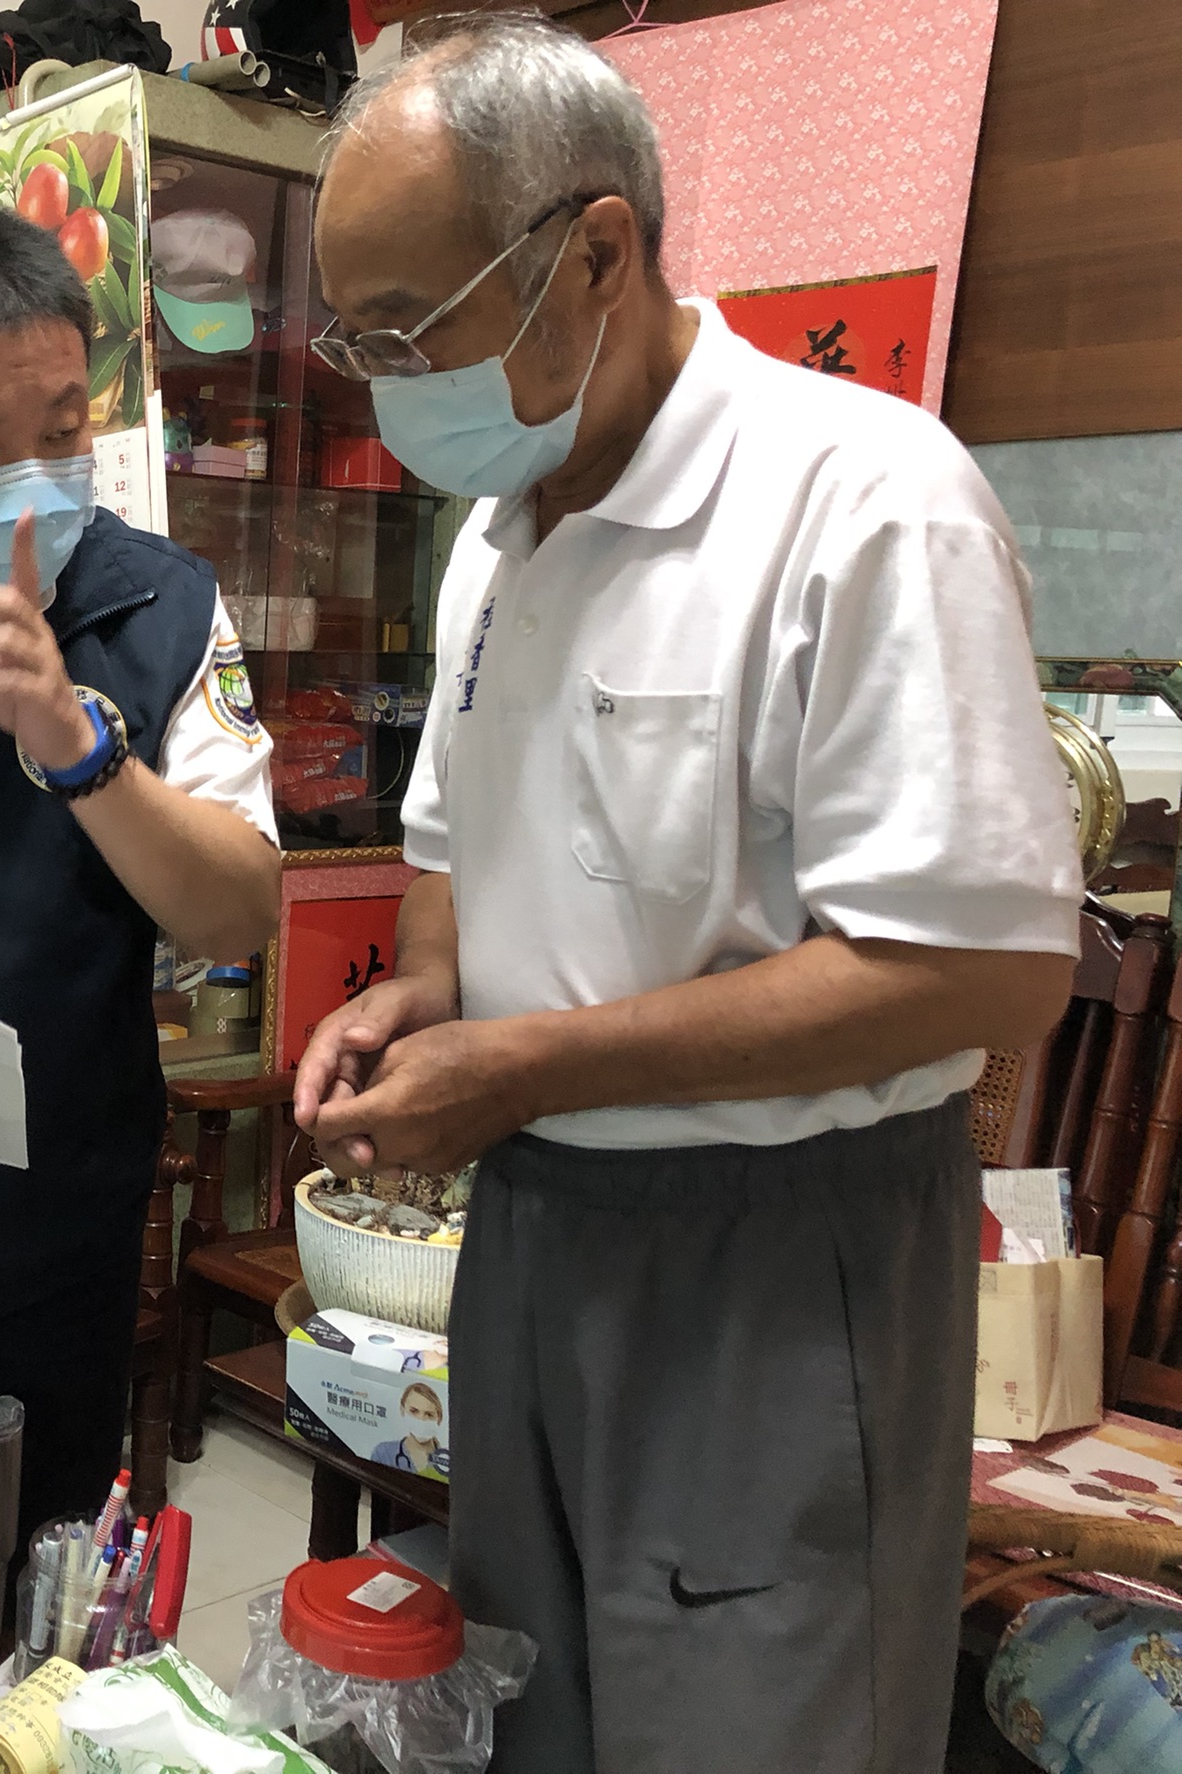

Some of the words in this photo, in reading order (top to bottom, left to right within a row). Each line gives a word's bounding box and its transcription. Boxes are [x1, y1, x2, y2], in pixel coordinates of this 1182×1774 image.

[118, 453, 125, 465] 5
[114, 480, 126, 493] 12
[115, 506, 127, 518] 19
[326, 1407, 357, 1422] Medical
[358, 1416, 378, 1428] Mask
